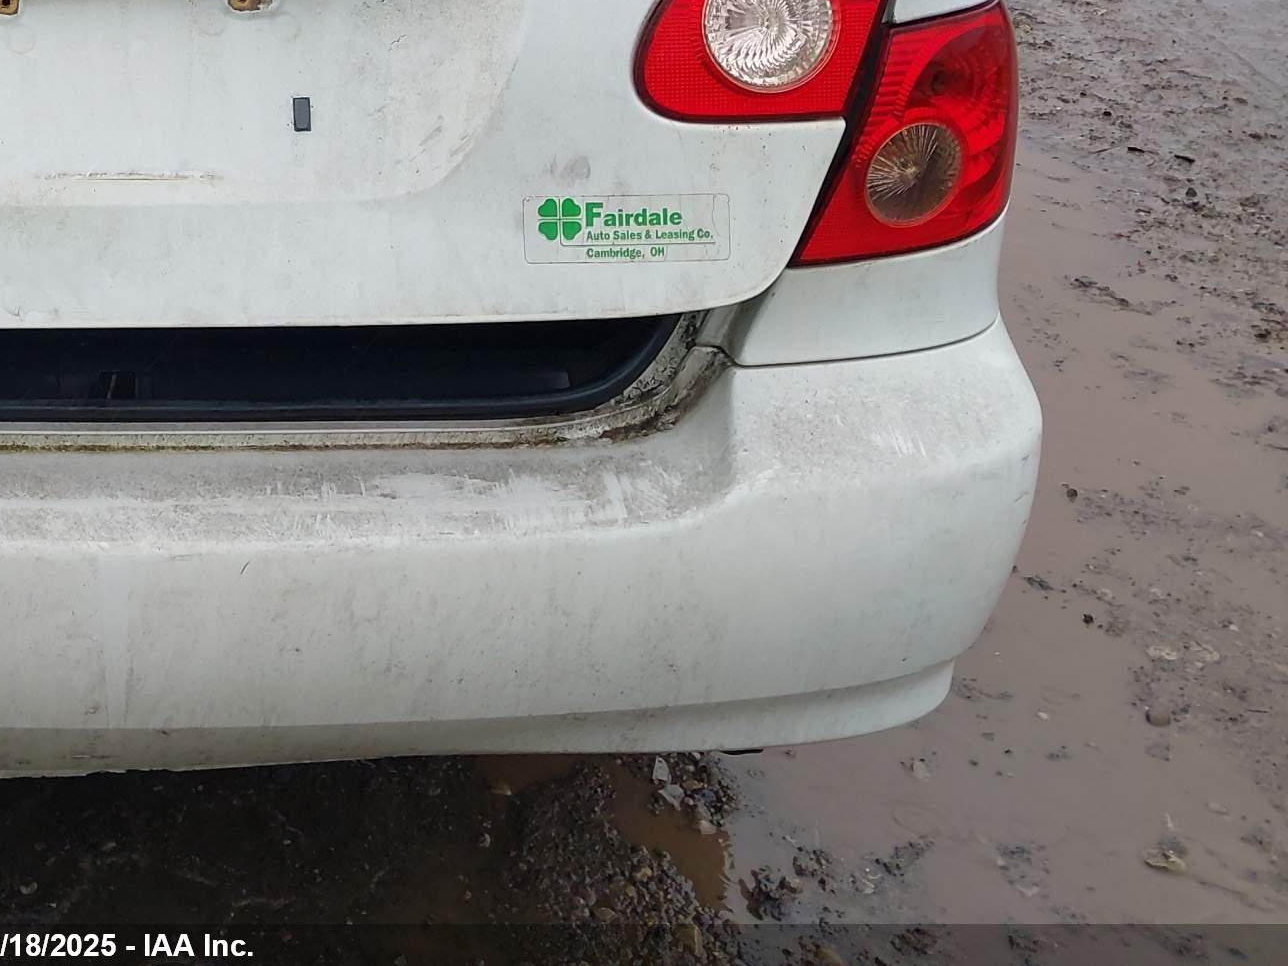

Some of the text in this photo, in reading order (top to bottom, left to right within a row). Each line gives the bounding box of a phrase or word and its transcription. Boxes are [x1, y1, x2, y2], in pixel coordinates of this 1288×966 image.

[585, 201, 682, 227] Fairdale
[586, 228, 713, 241] Auto Sales & Leasing Co.
[586, 246, 665, 260] Cambridge, OH
